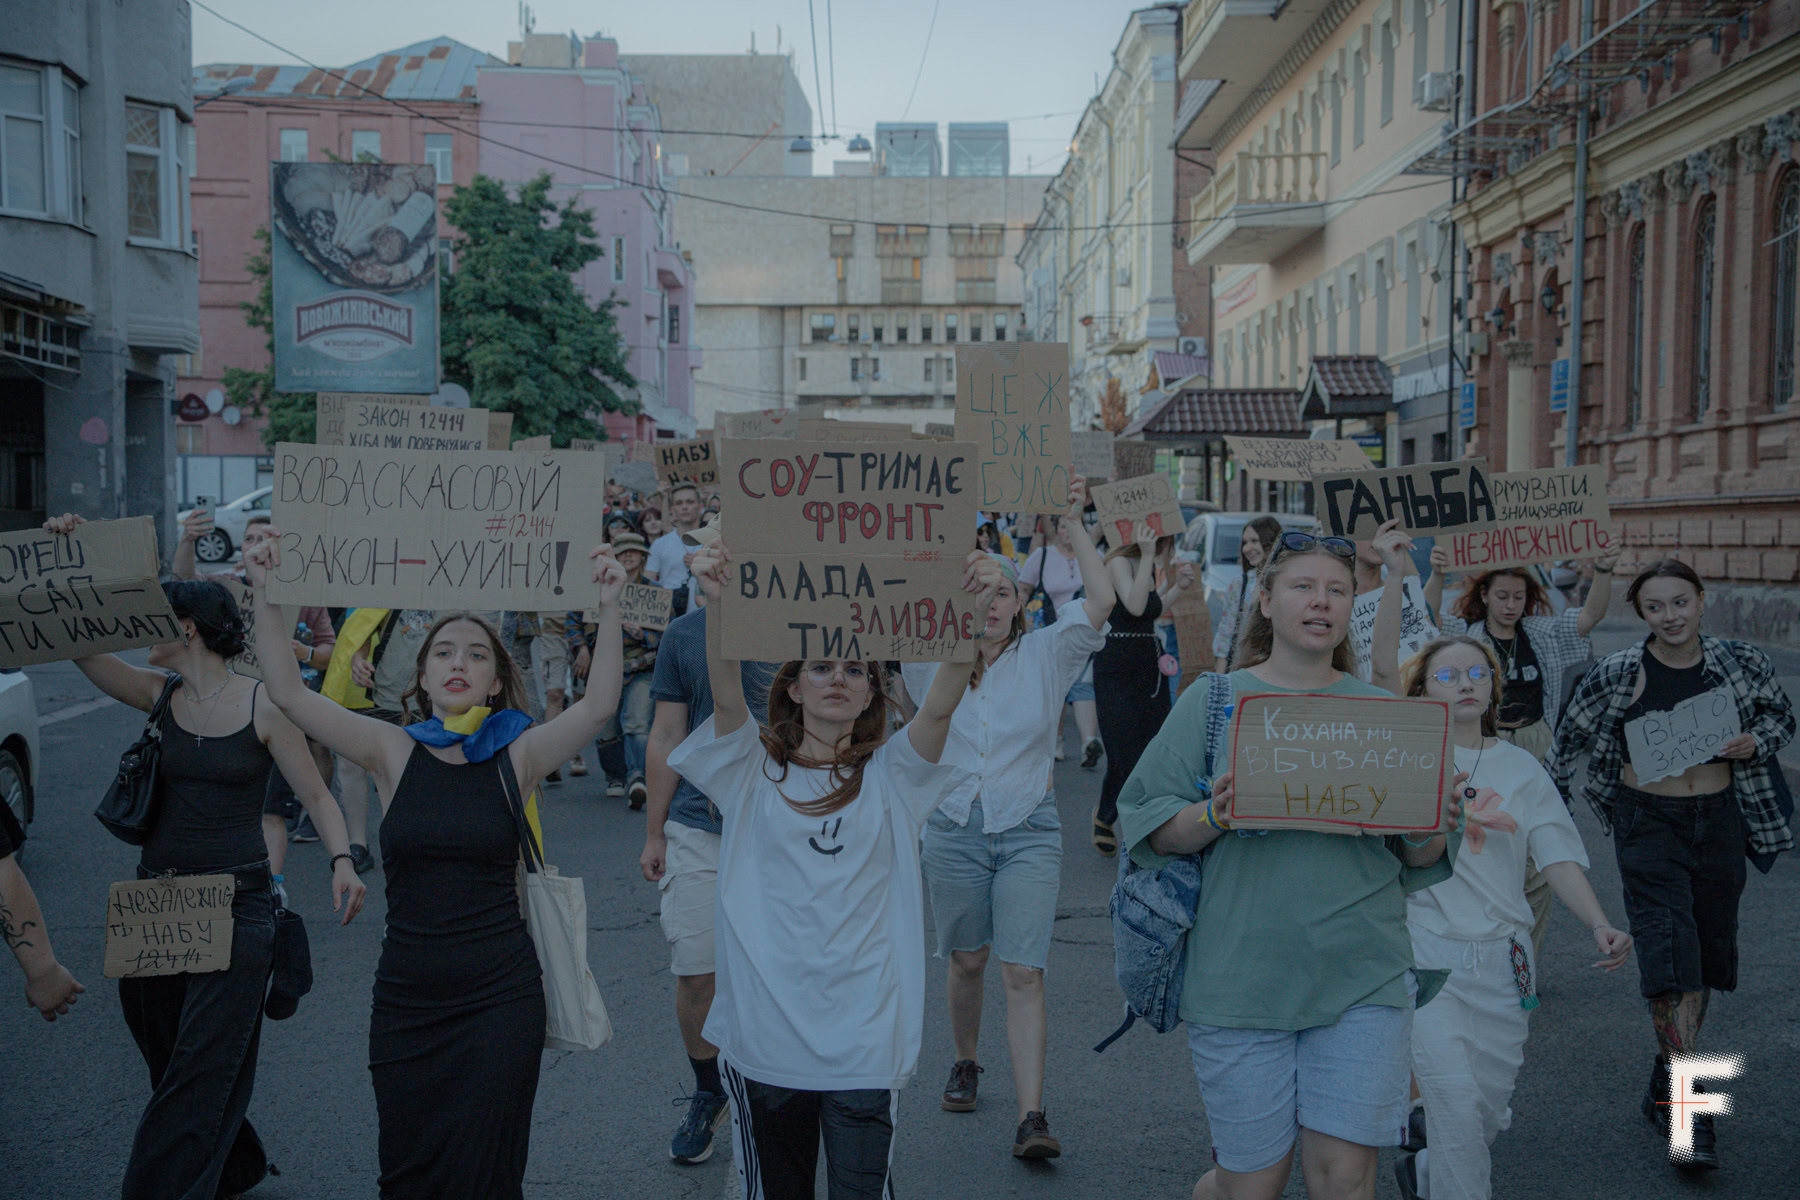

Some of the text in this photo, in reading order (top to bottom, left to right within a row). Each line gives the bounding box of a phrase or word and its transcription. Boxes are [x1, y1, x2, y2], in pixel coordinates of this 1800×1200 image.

[970, 371, 1063, 416] ЦЕ Ж
[357, 404, 465, 432] ЗАКОН 12414
[349, 432, 379, 447] ХІБА
[383, 434, 403, 449] МИ
[407, 436, 482, 450] ПОВЕРНУЛИСЯ
[662, 442, 710, 466] НАБУ
[991, 418, 1053, 458] ВЖЕ
[982, 462, 1069, 508] БУЛО
[1323, 465, 1496, 537] ГАНЬБА
[484, 513, 555, 538] #12414
[803, 502, 945, 544] ФРОНТ,
[1498, 501, 1584, 521] ЗНИЩУВАТИ
[1453, 518, 1609, 568] НЕЗАЛЕЖНІСТЬ
[62, 614, 180, 643] КАЦАП
[850, 598, 973, 641] ЗЛИВАЄ
[788, 623, 870, 660] ТИЛ.
[890, 638, 959, 657] #12414
[1642, 694, 1727, 746] ВЕТО
[1679, 731, 1697, 746] НА
[1242, 745, 1436, 776] ВБИВАЄМО
[1651, 725, 1735, 771] ЗАКОН
[1283, 781, 1388, 819] НАБУ
[143, 920, 212, 945] НАБУ
